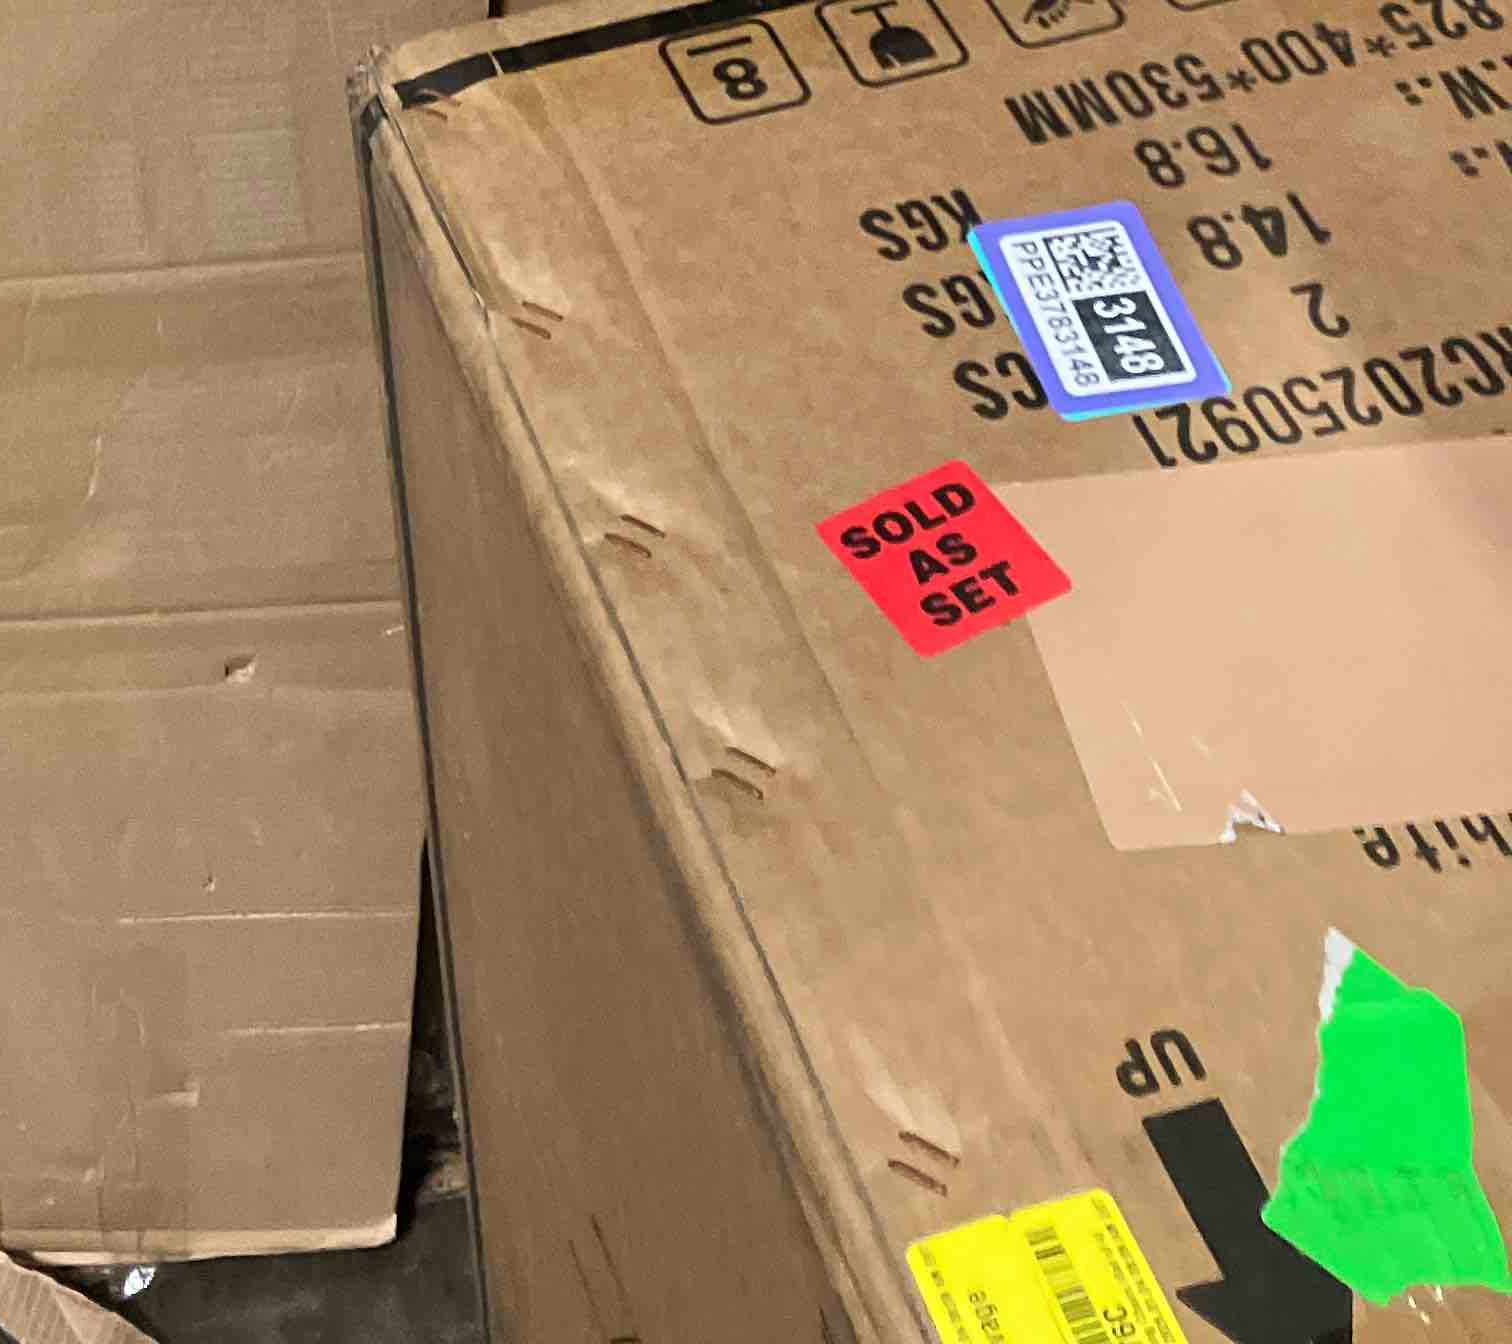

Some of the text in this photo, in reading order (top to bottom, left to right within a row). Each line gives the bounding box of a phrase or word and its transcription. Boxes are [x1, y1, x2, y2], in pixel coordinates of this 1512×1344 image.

[1133, 121, 1274, 189] 16.8
[901, 191, 1333, 339] 14.8 GS
[1011, 240, 1100, 388] PPE3783148
[1092, 296, 1165, 375] 3148
[952, 281, 1350, 421] 2 CS
[840, 483, 977, 560] SOLD
[909, 532, 979, 585] AS
[919, 560, 1020, 627] SET
[1352, 810, 1512, 874] hite
[1114, 1028, 1208, 1098] UP
